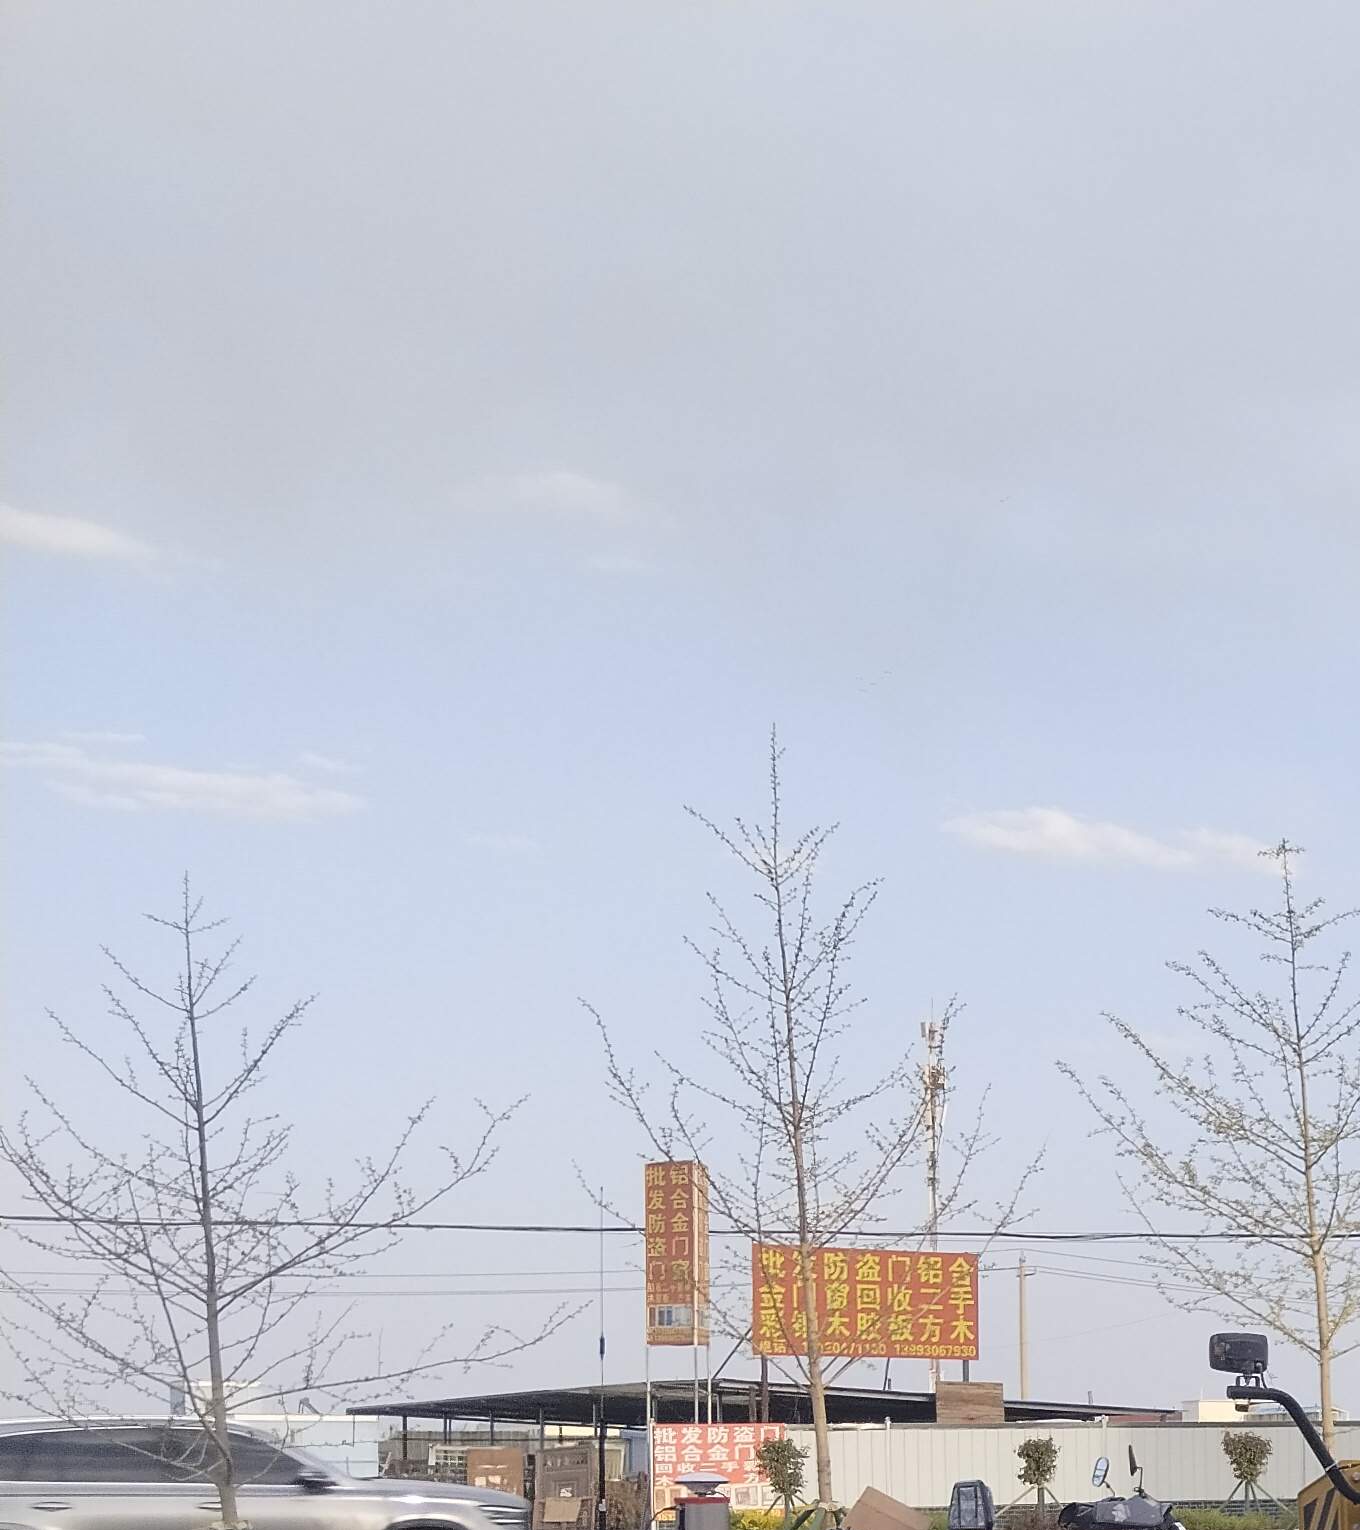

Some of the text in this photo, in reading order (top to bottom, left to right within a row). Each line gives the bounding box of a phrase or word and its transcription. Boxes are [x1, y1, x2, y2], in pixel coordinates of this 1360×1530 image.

[646, 1166, 666, 1281] 批发防盗门
[654, 1425, 780, 1445] 批发防盗门
